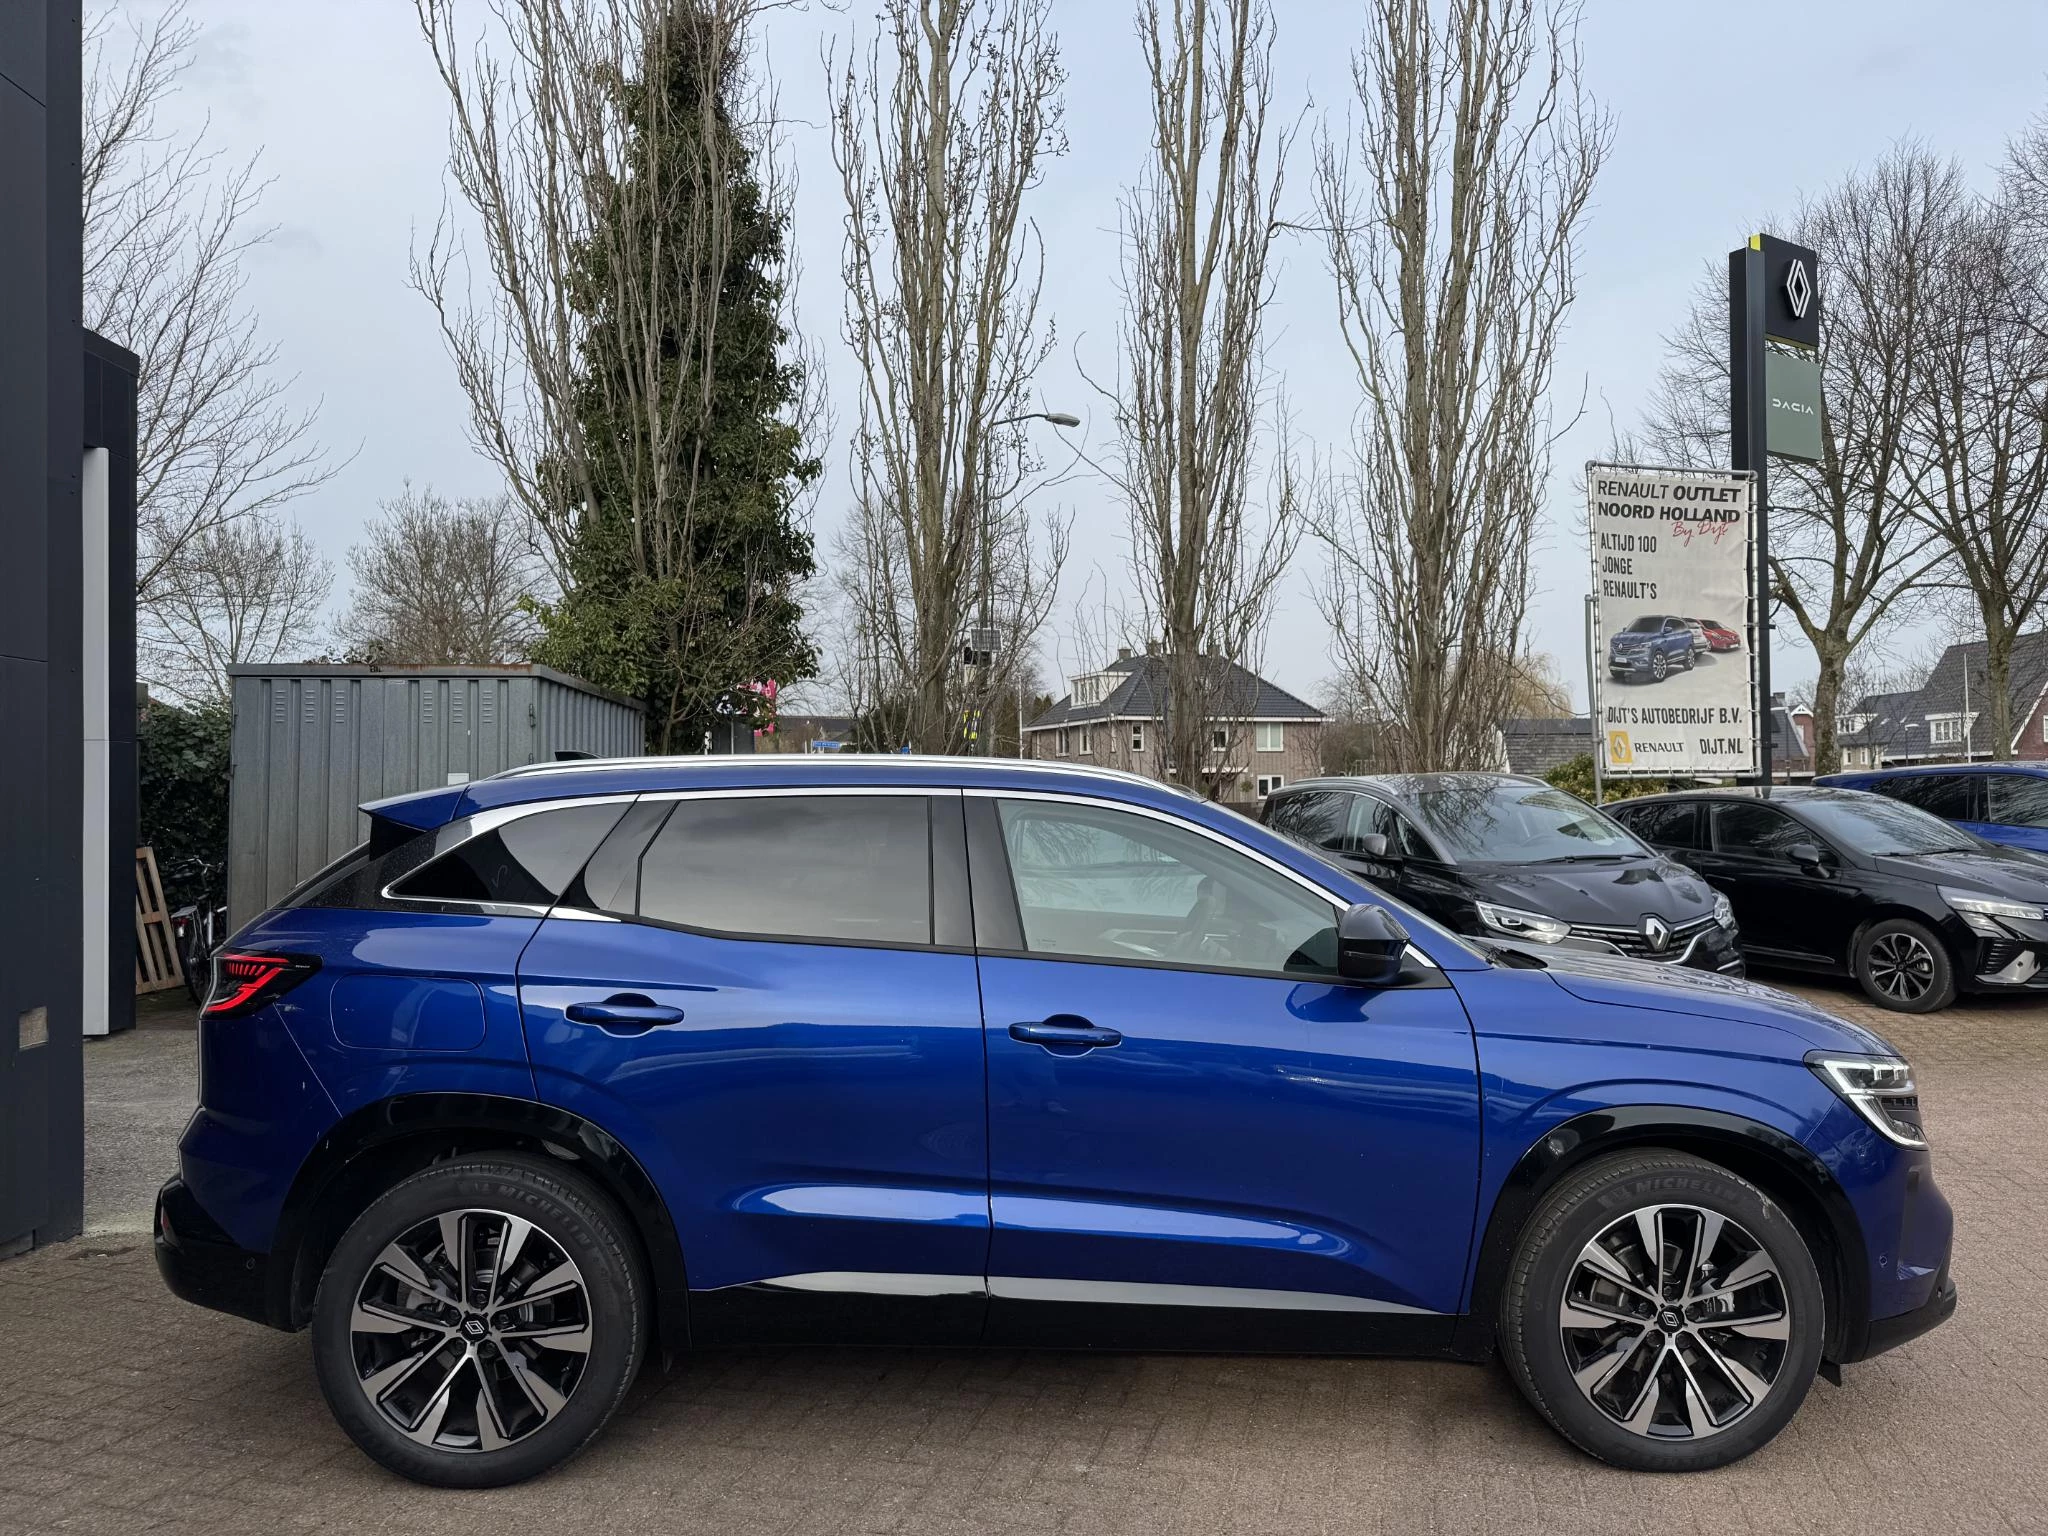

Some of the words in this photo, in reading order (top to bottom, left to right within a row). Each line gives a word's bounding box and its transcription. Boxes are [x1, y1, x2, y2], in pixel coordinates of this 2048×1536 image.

[1772, 398, 1814, 415] DACIA
[1598, 480, 1669, 499] RENAULT
[1673, 485, 1741, 503] OUTLET
[1598, 502, 1655, 519] NOORD
[1659, 506, 1740, 523] HOLLAND
[1601, 532, 1634, 551] ALTIJD
[1638, 535, 1657, 553] 100
[1671, 521, 1694, 547] By
[1602, 556, 1633, 575] JONGE
[1603, 579, 1657, 600] RENAULT'S
[1608, 706, 1638, 724] DIJT'S
[1641, 708, 1715, 724] AUTOBEDRIJF
[1719, 707, 1742, 724] B.V.
[1634, 742, 1684, 753] RENAULT
[1699, 738, 1744, 755] DIJT.NL
[1636, 1177, 1737, 1201] MICHELIN
[498, 1184, 591, 1246] MICHELIN
